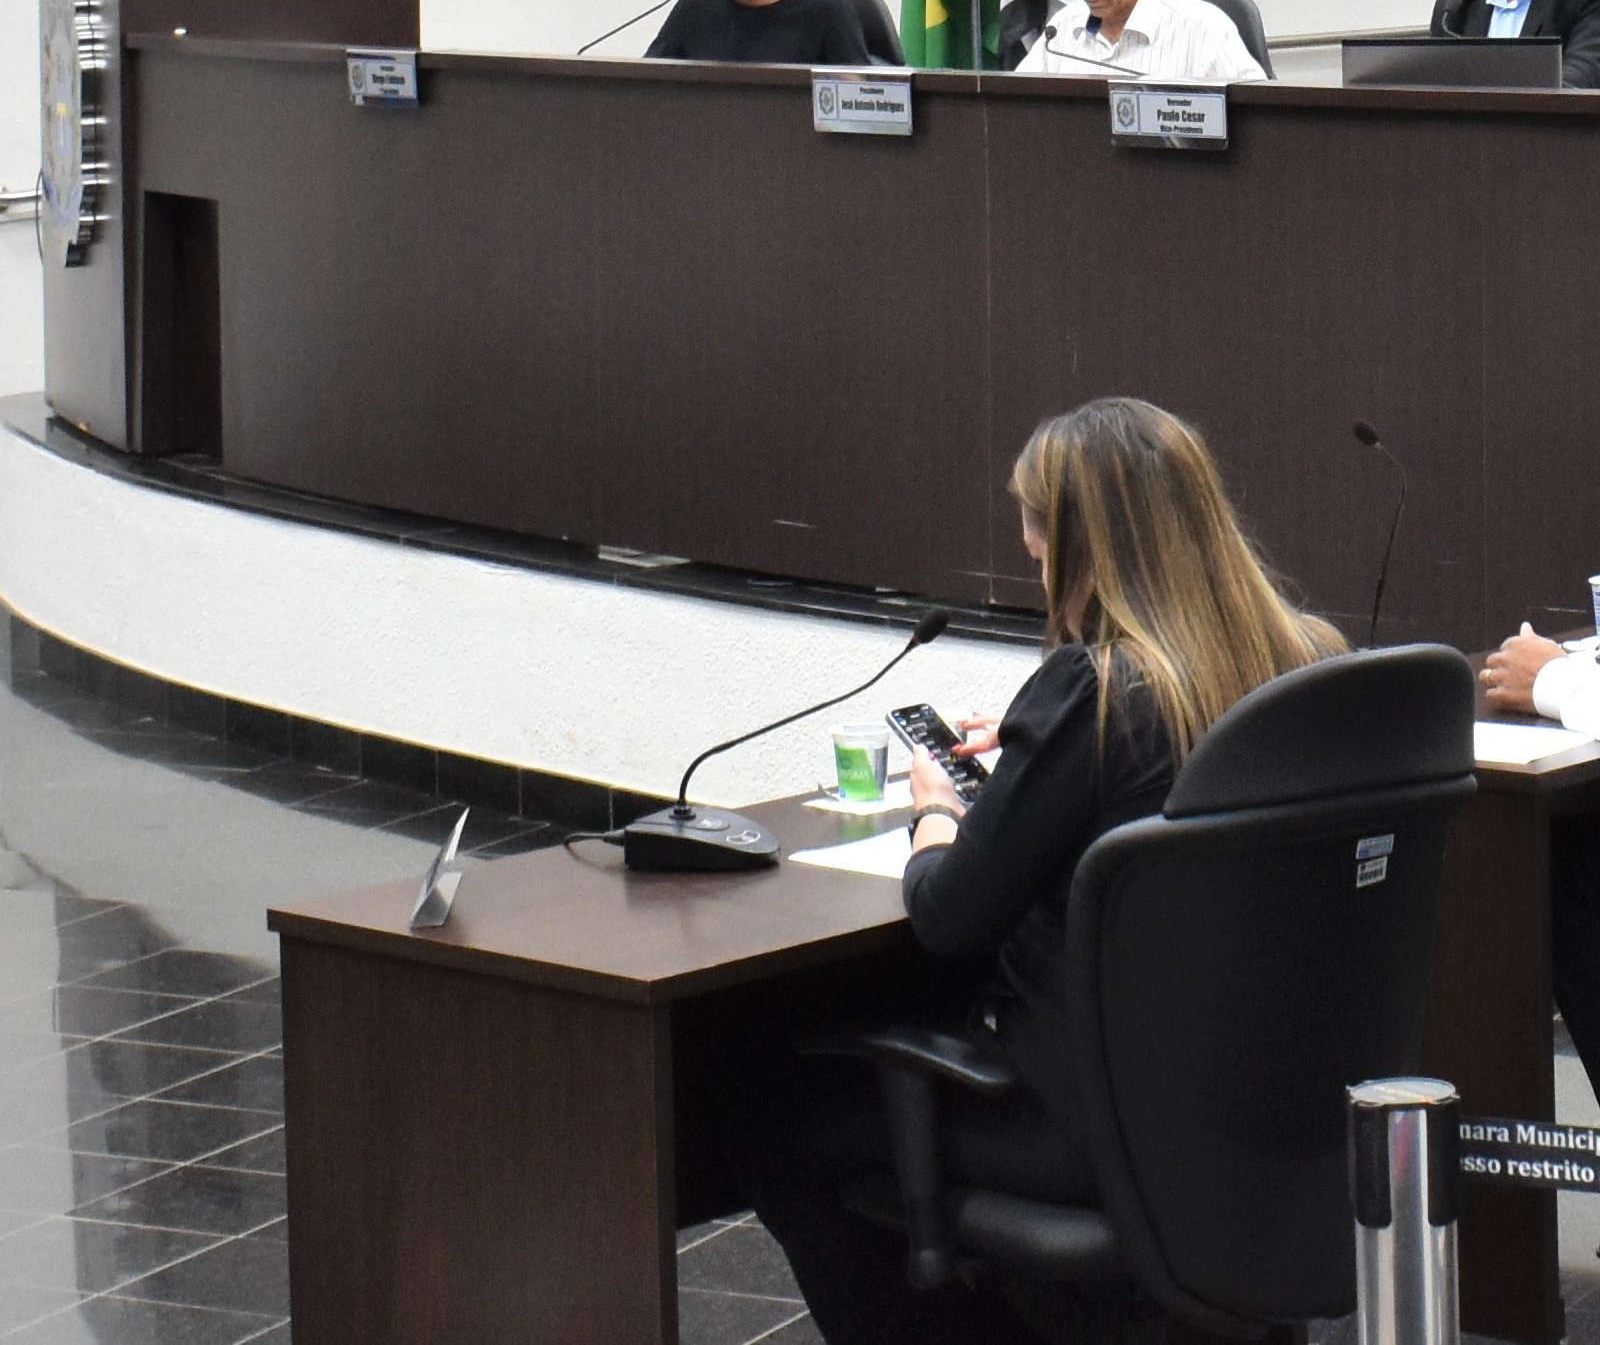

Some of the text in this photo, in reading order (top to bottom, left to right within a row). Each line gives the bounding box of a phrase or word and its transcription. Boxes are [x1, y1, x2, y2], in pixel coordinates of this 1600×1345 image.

[1157, 109, 1206, 123] Paulo Cesar
[1459, 1123, 1510, 1143] mara
[1461, 1156, 1501, 1174] sso
[1507, 1159, 1595, 1184] restrito
